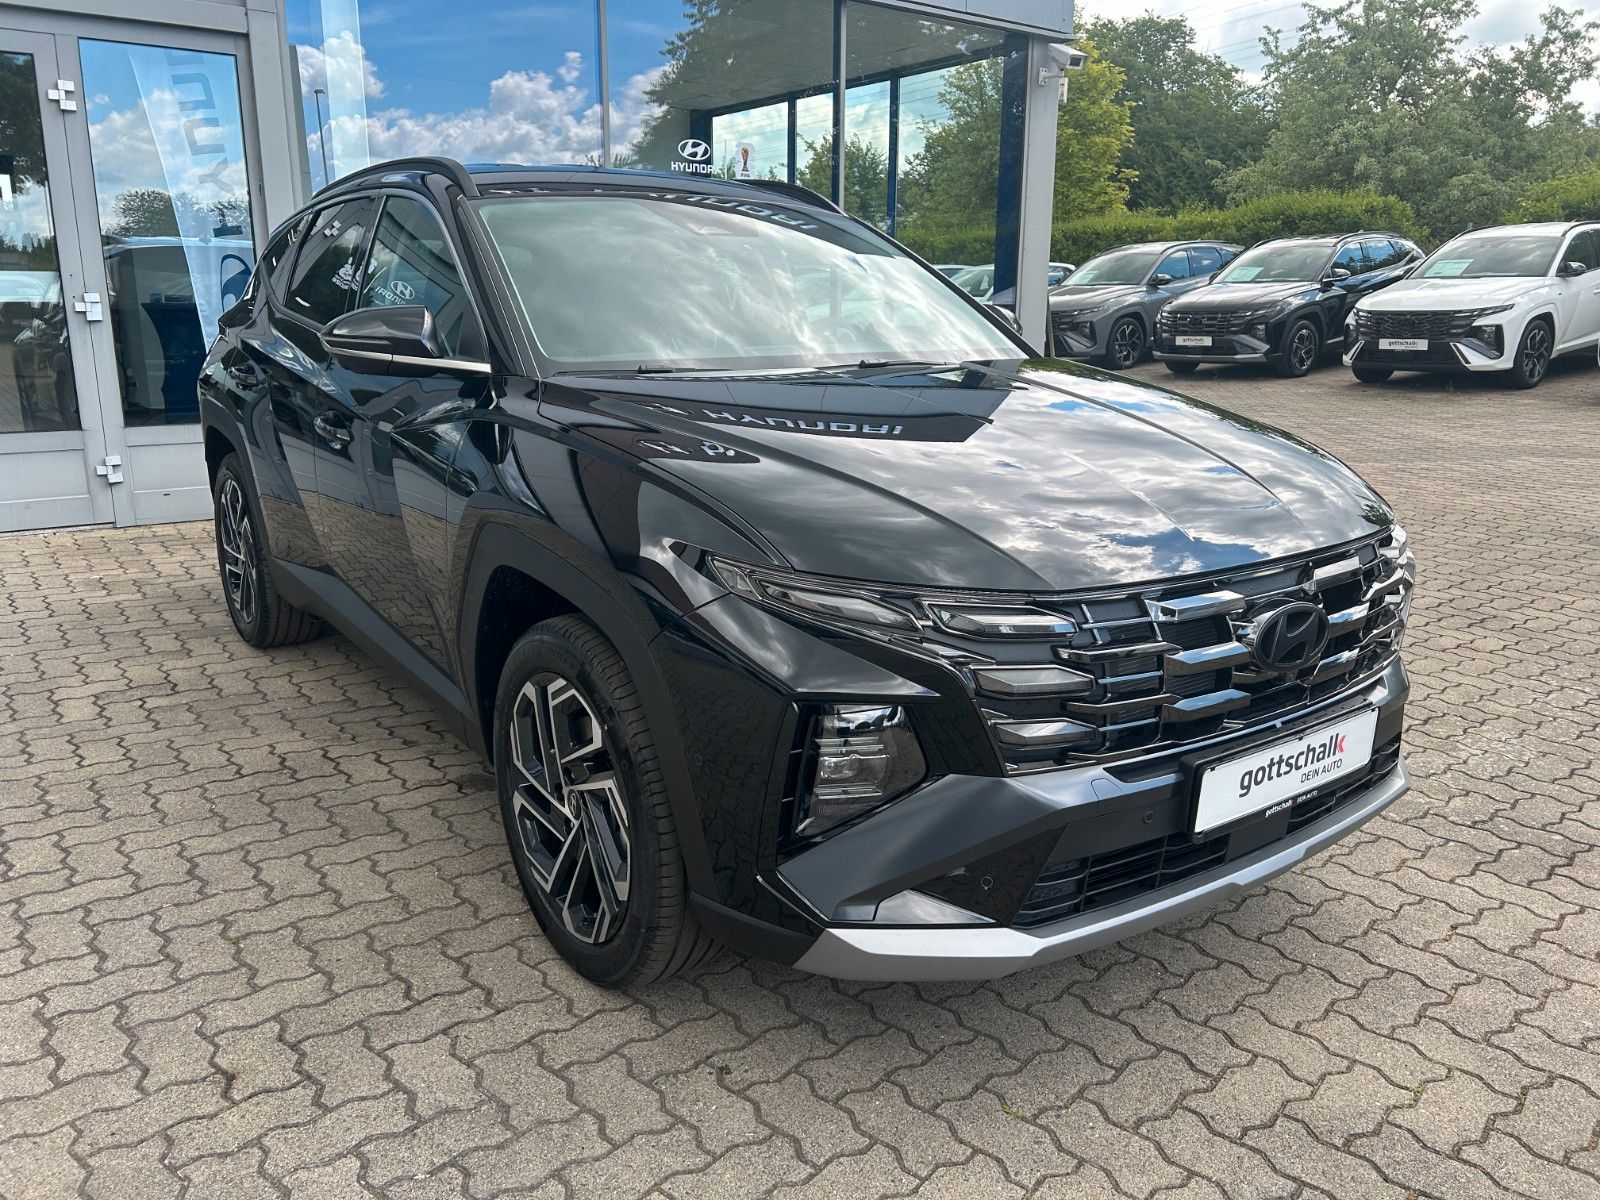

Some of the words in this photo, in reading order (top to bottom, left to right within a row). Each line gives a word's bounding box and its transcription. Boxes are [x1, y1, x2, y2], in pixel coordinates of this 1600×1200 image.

[671, 161, 717, 174] HYUNDA
[1238, 732, 1347, 799] gottschalk
[1300, 768, 1319, 784] DEIN
[1320, 758, 1343, 776] AUTO
